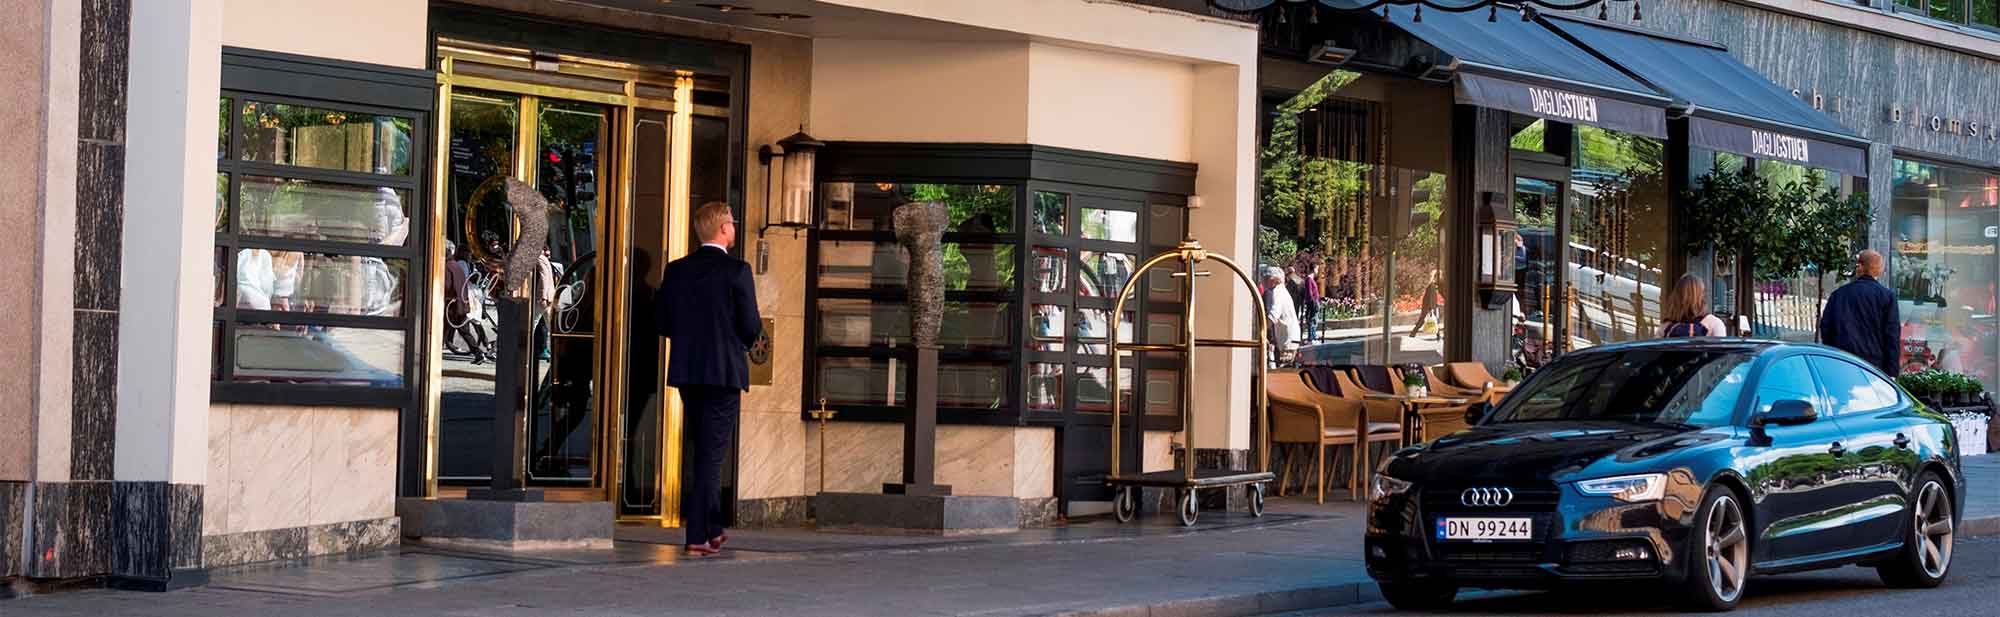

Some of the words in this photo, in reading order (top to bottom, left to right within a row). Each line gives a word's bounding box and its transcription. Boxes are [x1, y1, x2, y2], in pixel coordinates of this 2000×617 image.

[1528, 87, 1598, 122] DAGLIGSTUEN
[1751, 130, 1809, 162] DAGLIGSTUEN
[1449, 520, 1470, 537] DN
[1477, 520, 1529, 537] 99244
